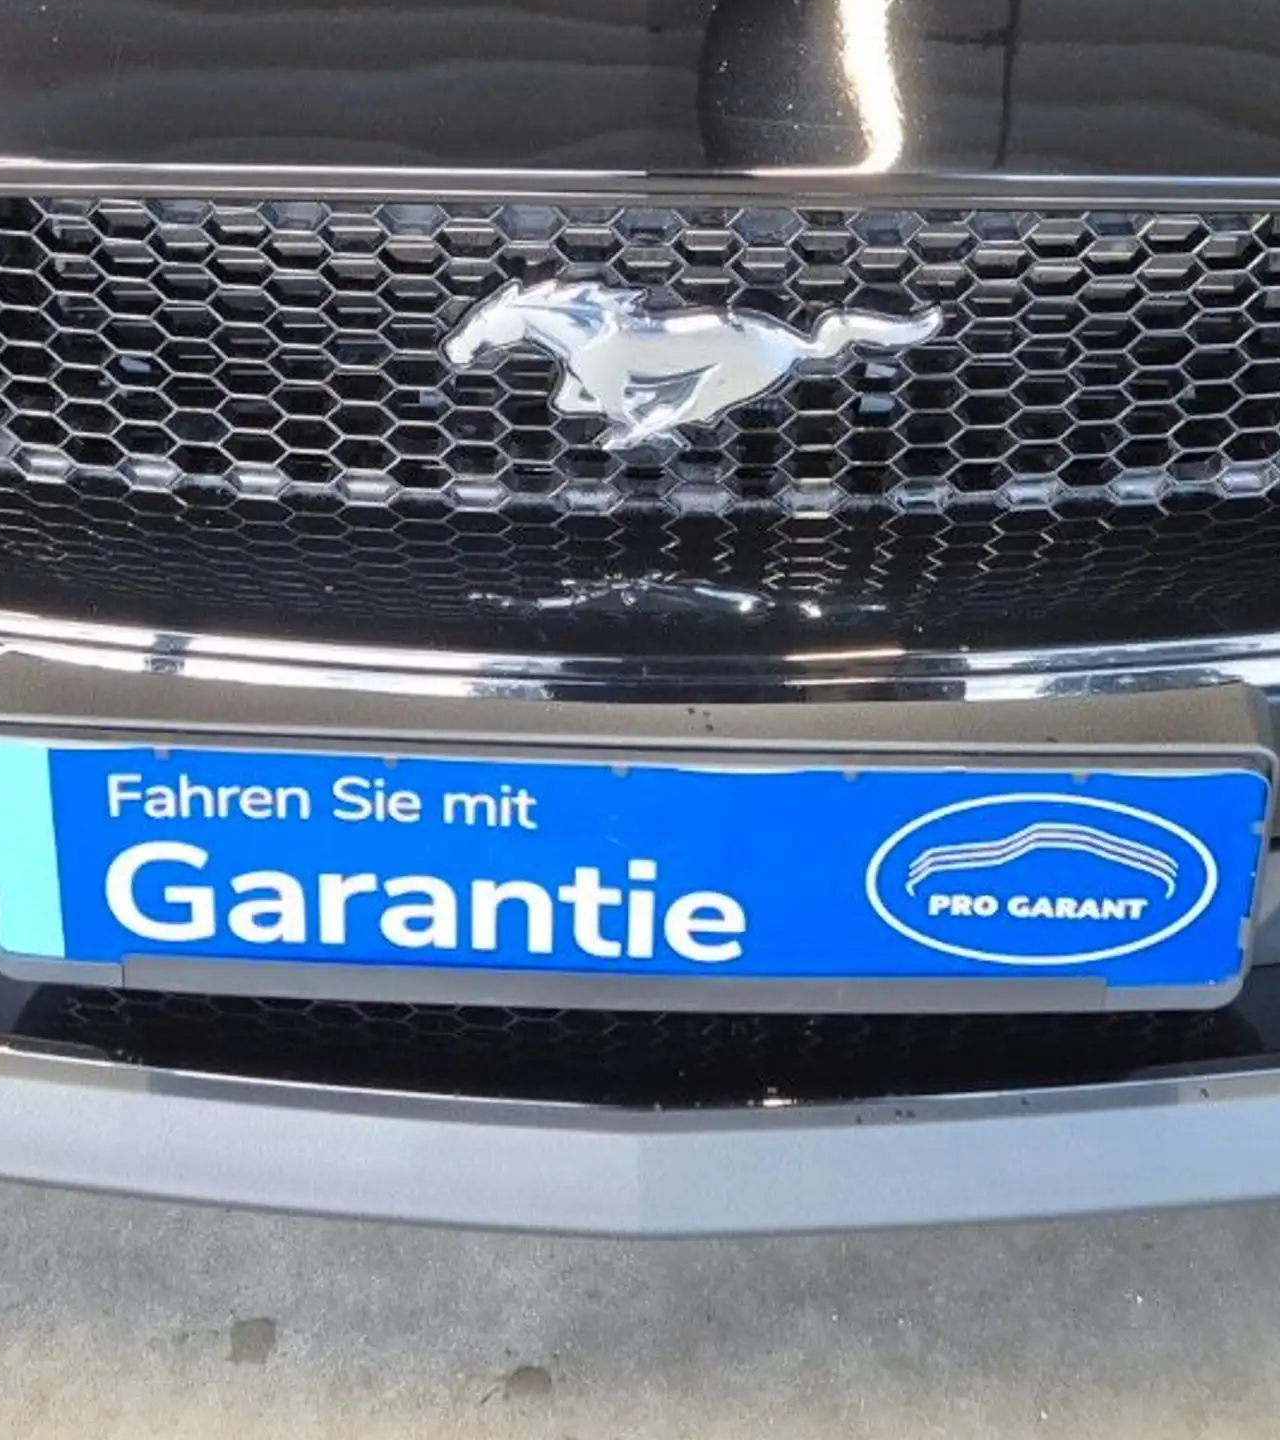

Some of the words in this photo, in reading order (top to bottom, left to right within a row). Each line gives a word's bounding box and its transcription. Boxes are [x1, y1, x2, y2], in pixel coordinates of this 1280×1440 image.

[106, 772, 311, 820] Fahren
[331, 775, 423, 823] Sie
[442, 783, 539, 830] mit
[103, 839, 748, 963] Garantie
[927, 893, 1000, 917] PRO
[1006, 895, 1149, 920] GARANT
